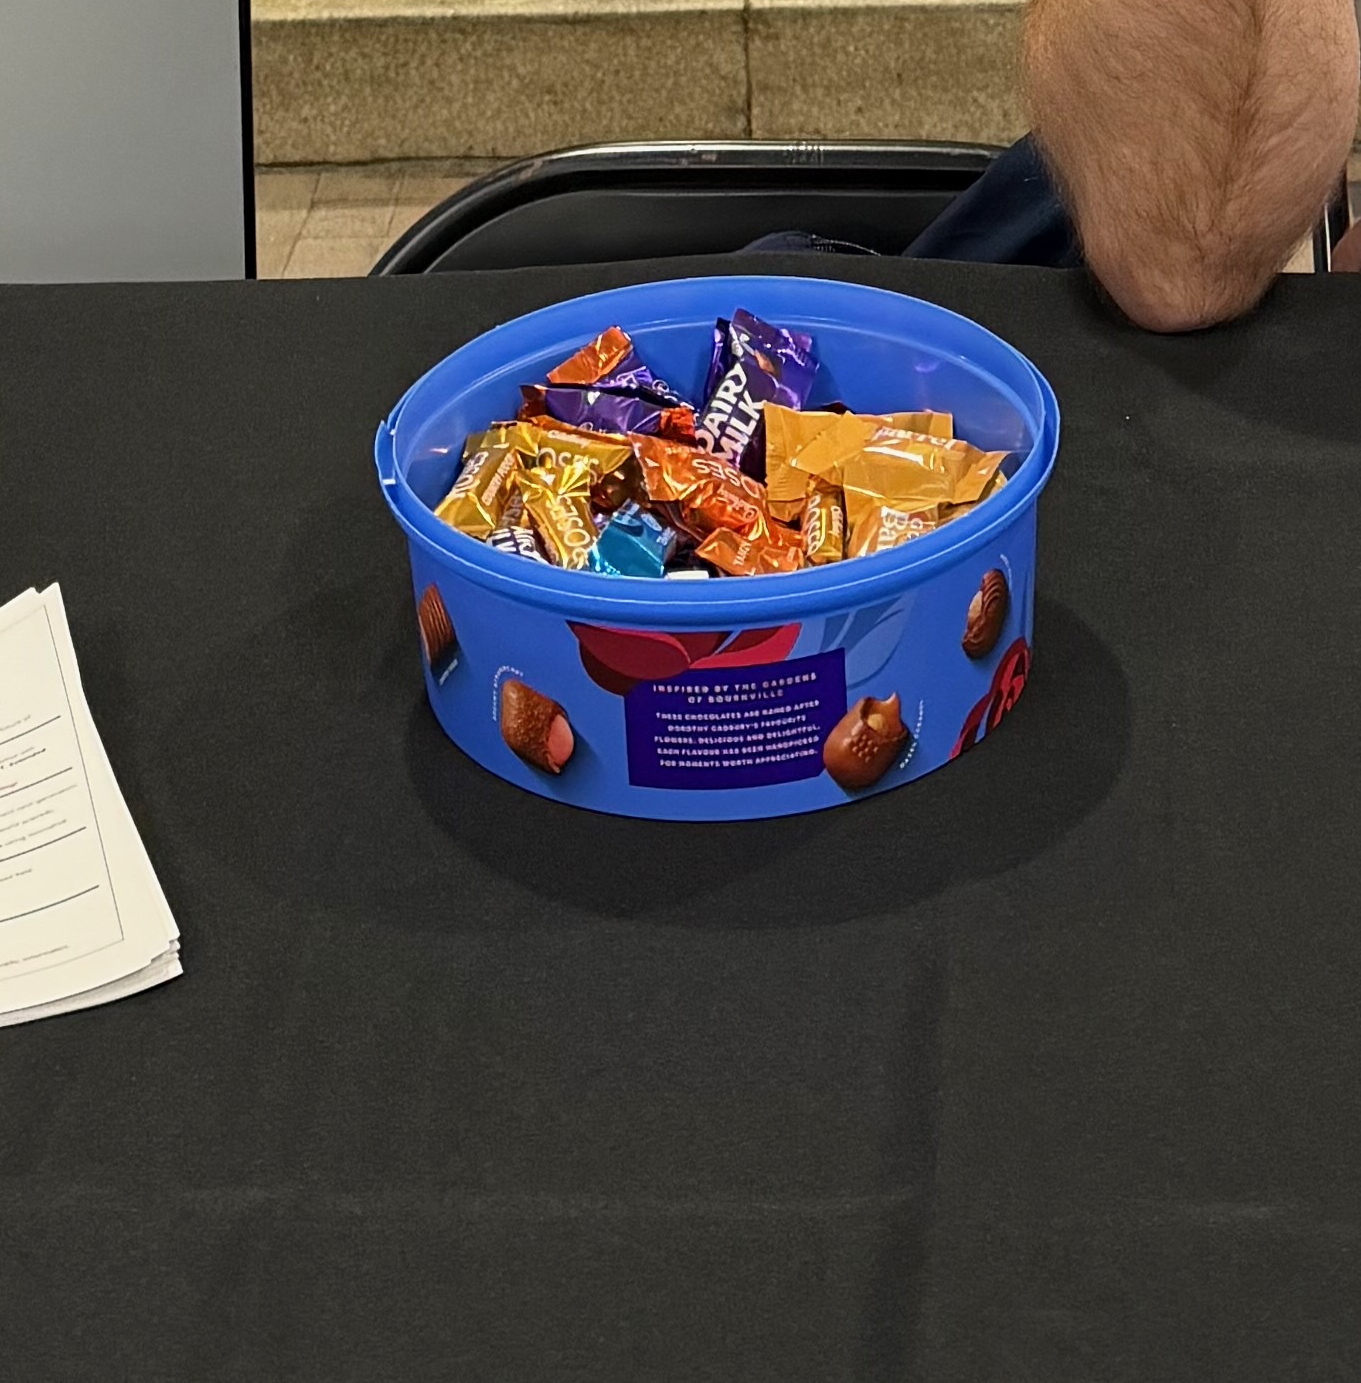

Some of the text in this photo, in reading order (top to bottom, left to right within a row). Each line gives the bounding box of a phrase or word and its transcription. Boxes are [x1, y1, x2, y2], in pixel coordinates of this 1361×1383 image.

[695, 363, 747, 454] DAIRY
[716, 388, 766, 462] MILK
[653, 672, 817, 693] INSPIRED BY THE GARDENS
